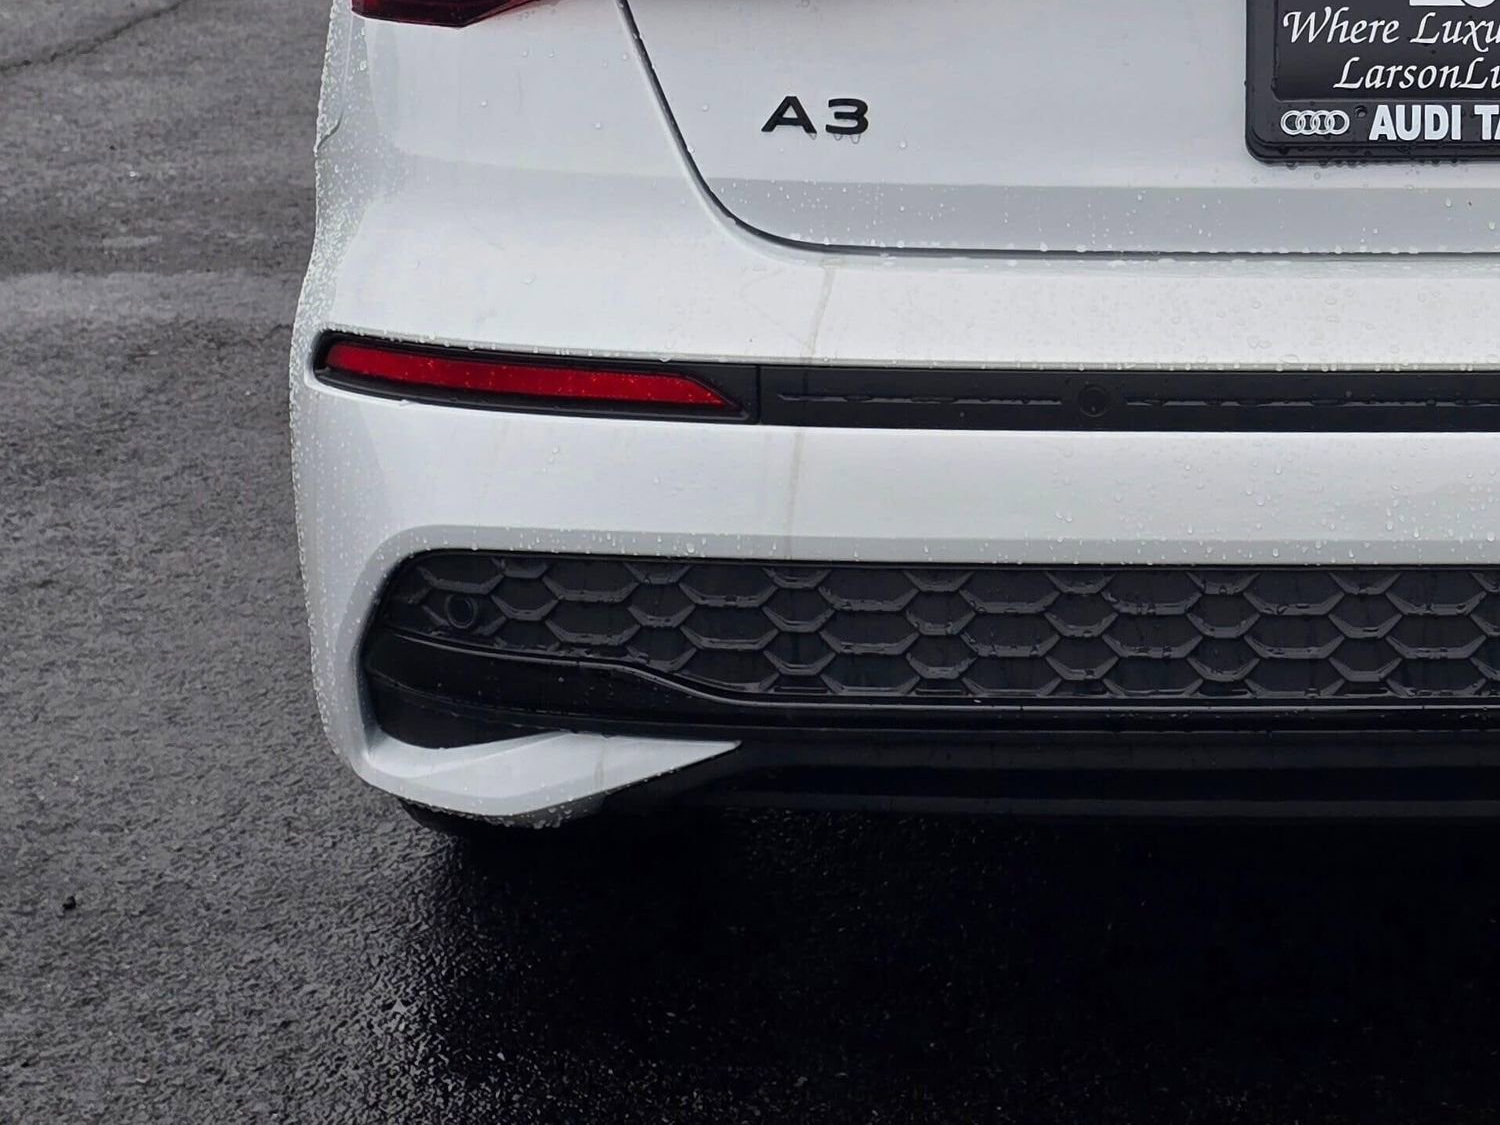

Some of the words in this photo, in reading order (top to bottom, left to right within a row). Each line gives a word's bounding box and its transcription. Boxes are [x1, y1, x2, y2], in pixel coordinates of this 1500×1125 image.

[1282, 6, 1400, 44] Where
[760, 95, 869, 136] A3
[1368, 104, 1462, 141] AUDI
